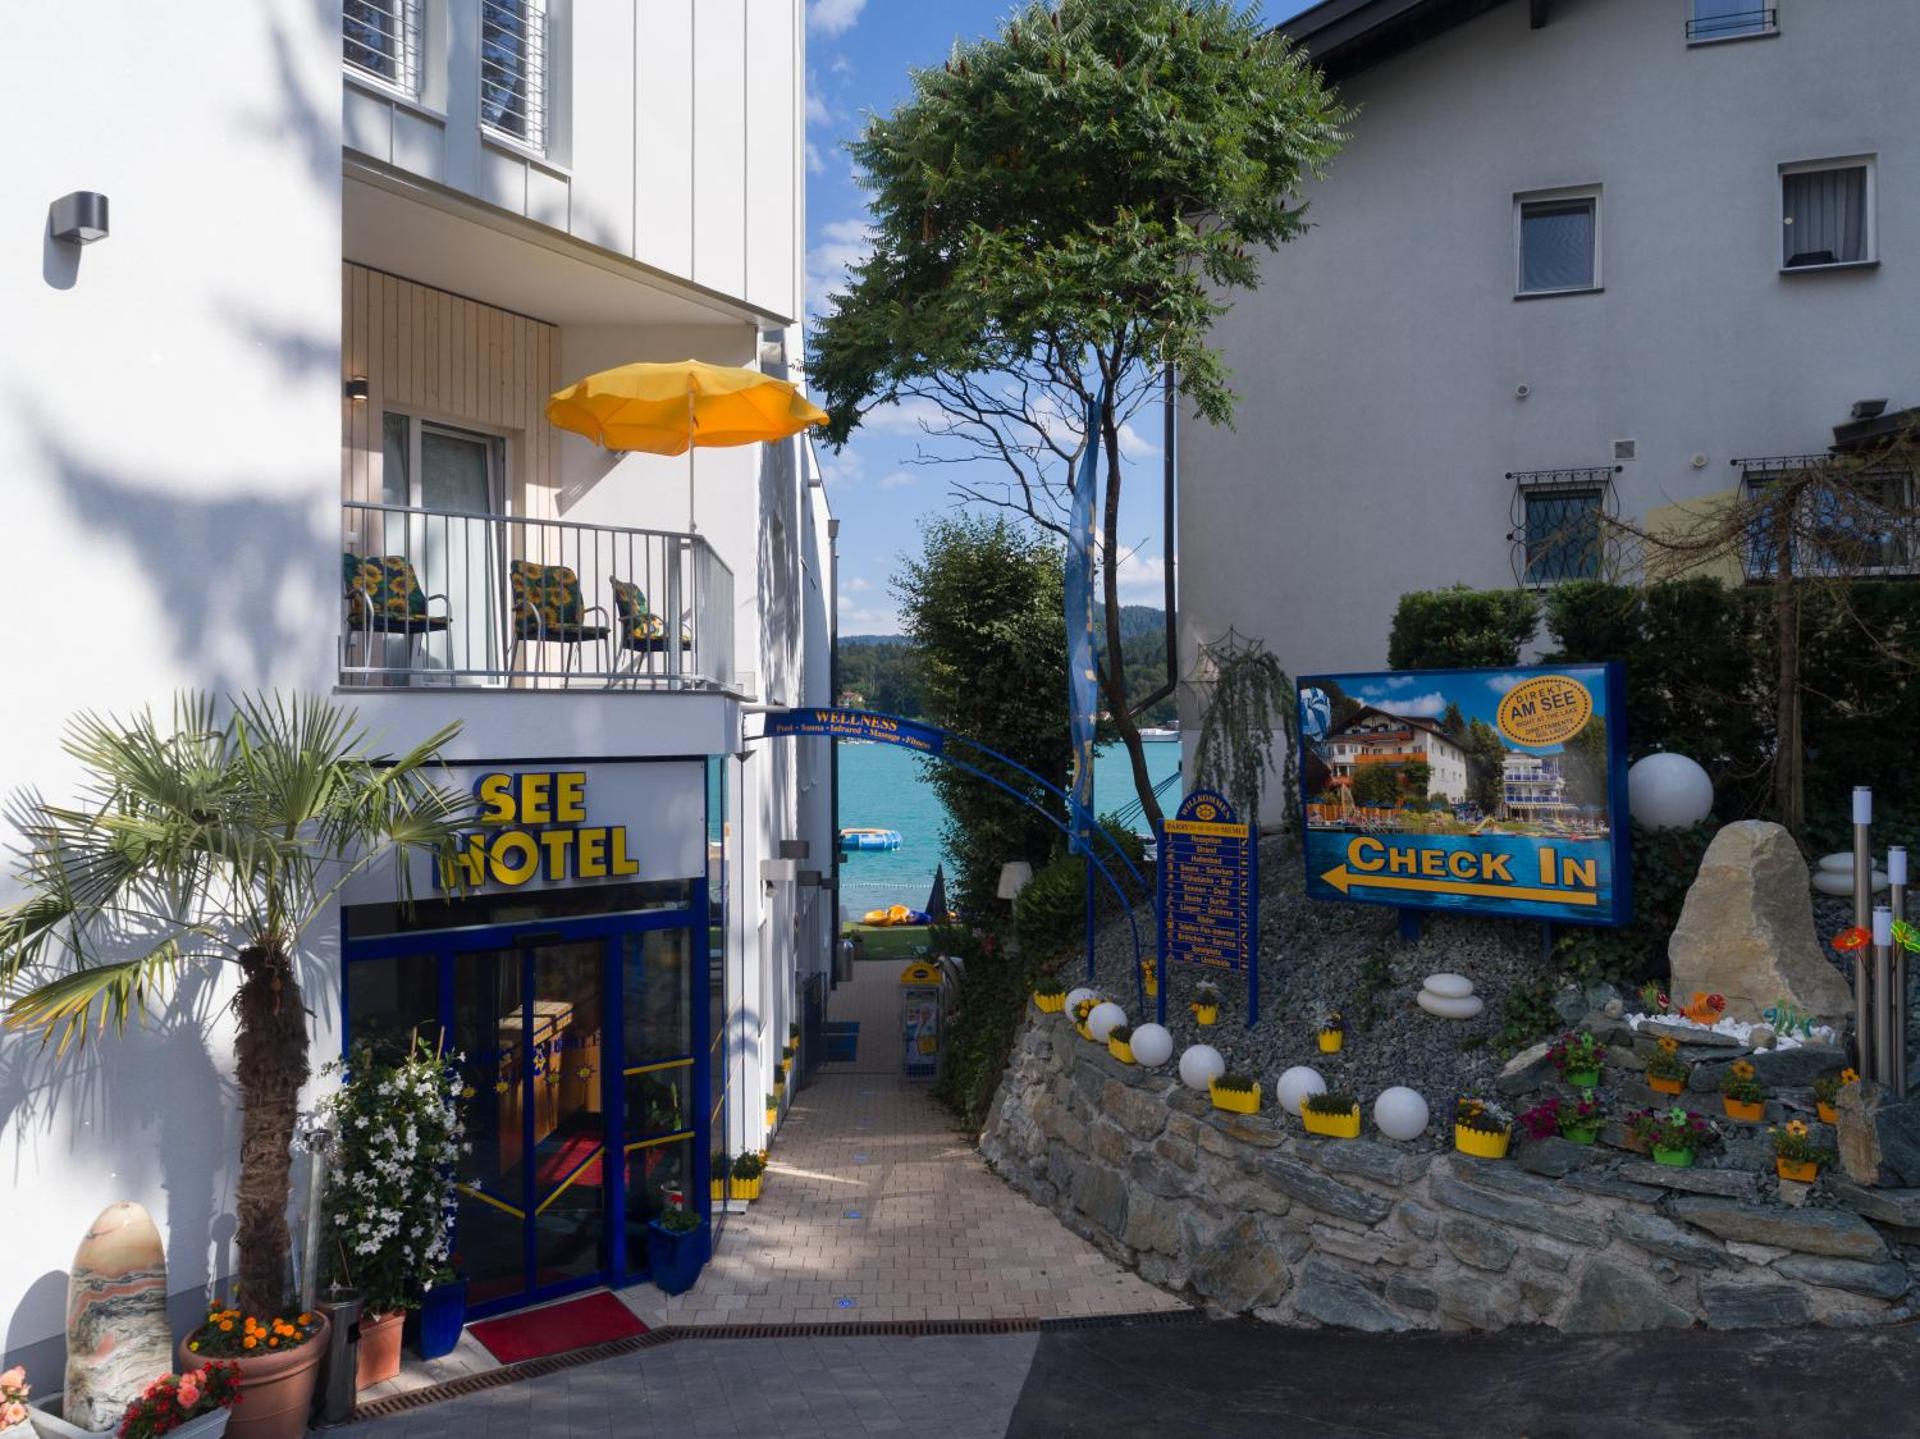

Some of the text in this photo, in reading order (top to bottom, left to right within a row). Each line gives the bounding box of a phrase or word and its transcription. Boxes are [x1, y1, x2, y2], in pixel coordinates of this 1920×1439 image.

[1511, 690, 1576, 721] AM SEE
[1516, 683, 1562, 703] DIREKT
[816, 711, 899, 731] WELLNESS
[869, 728, 900, 743] Massage
[472, 771, 587, 825] SEE
[1181, 794, 1230, 820] WILLKOMMEN
[432, 826, 640, 889] HOTEL
[1347, 836, 1598, 887] CHECK IN
